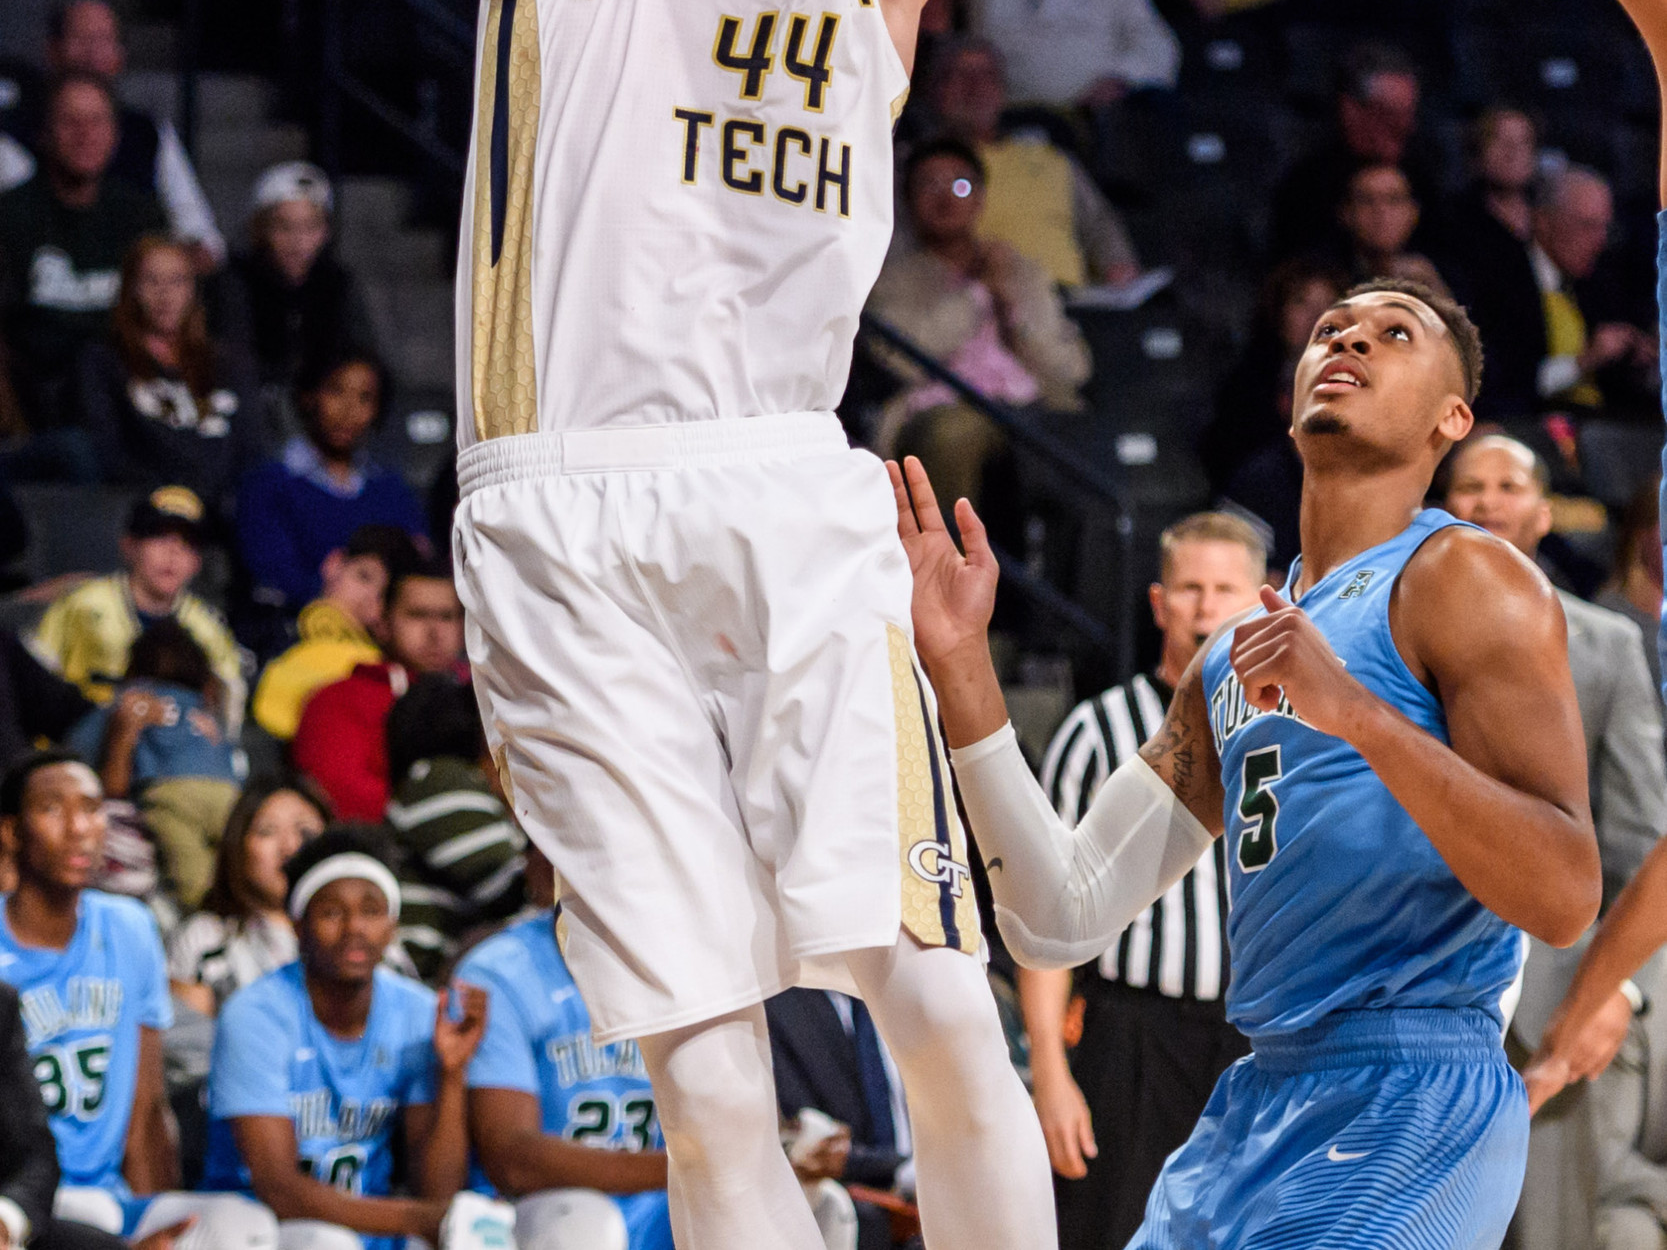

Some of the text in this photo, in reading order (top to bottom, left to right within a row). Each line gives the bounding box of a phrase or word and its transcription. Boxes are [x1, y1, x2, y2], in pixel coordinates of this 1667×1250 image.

[711, 11, 841, 113] 44
[673, 106, 852, 220] TECH
[1237, 744, 1282, 874] 5
[908, 839, 970, 898] GT
